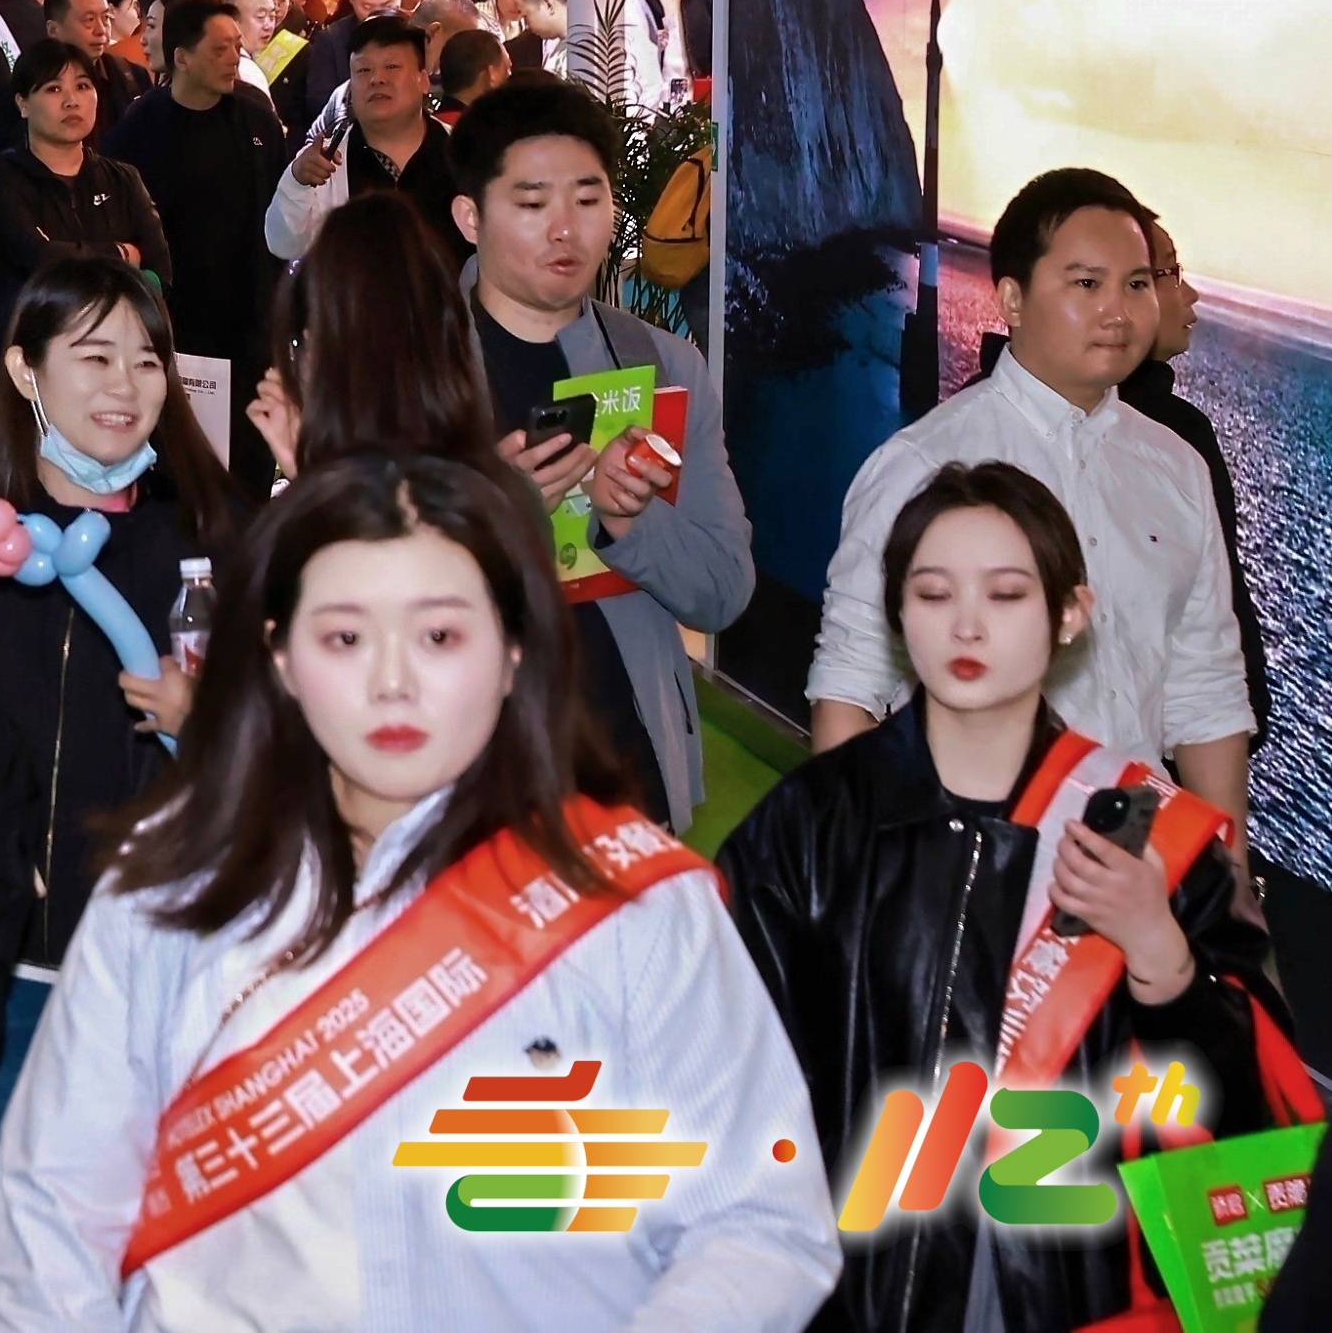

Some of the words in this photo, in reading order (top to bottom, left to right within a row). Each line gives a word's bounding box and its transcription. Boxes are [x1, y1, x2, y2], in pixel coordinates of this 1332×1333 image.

[173, 947, 490, 1206] 第三十三届上海国际
[215, 1034, 321, 1121] SHANGHAI
[317, 989, 371, 1042] 2025
